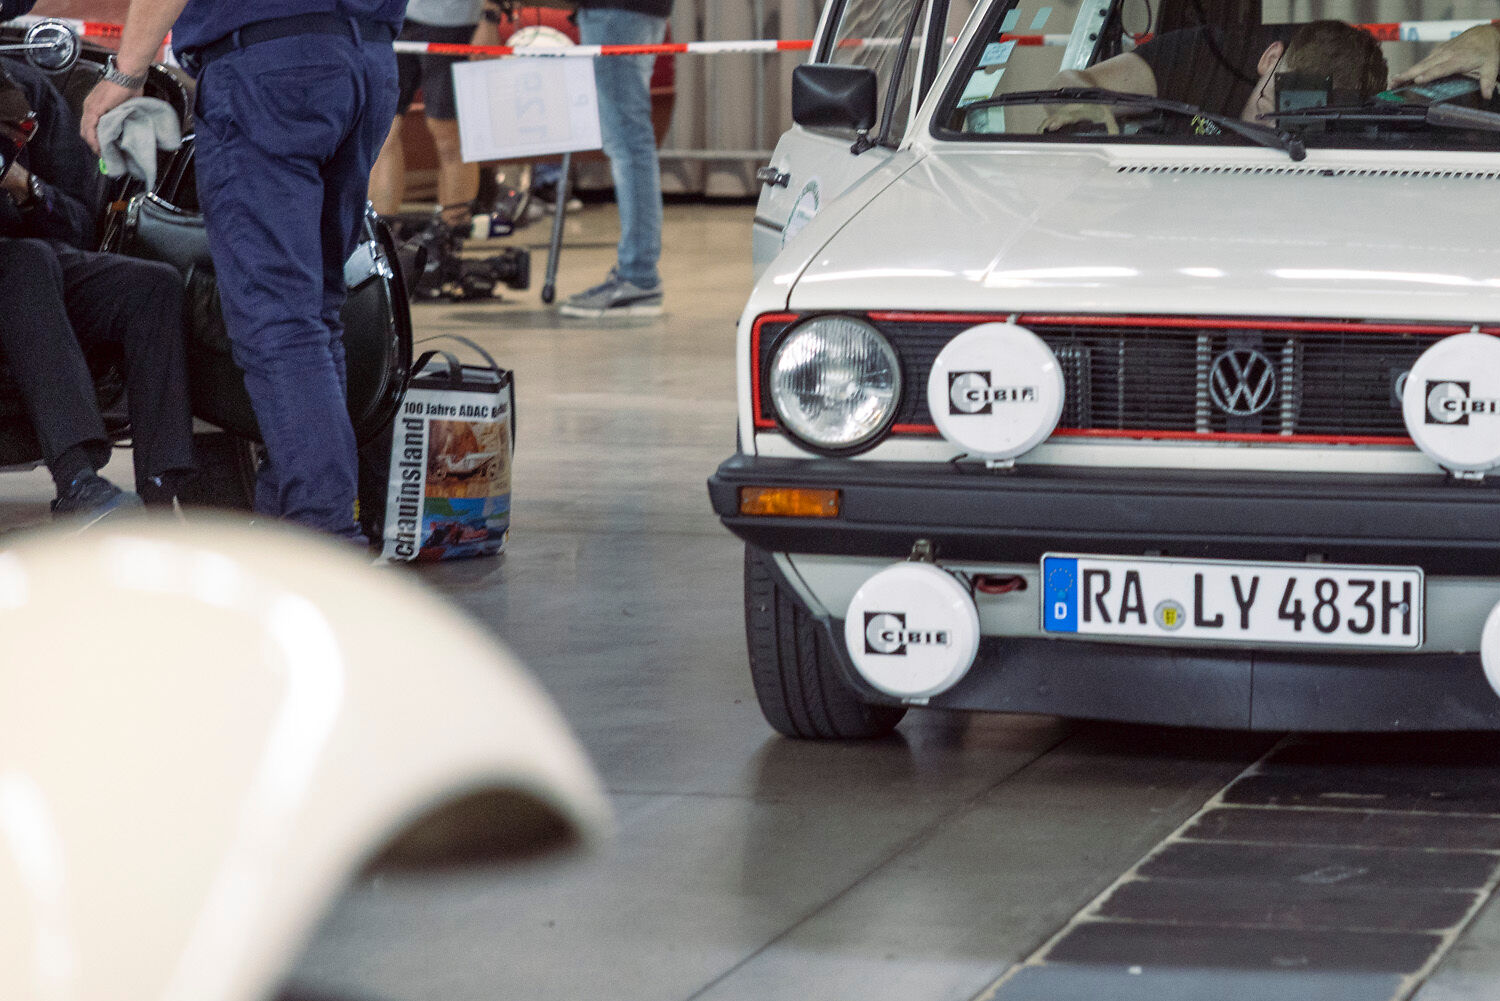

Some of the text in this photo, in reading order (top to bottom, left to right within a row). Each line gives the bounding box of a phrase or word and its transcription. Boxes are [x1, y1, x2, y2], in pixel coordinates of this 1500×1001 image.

[404, 402, 424, 415] 100
[426, 403, 457, 416] Jahre
[458, 404, 489, 418] ADAC
[395, 417, 425, 558] chauinsland
[1054, 602, 1067, 619] D
[1083, 568, 1412, 636] RA LY 483H
